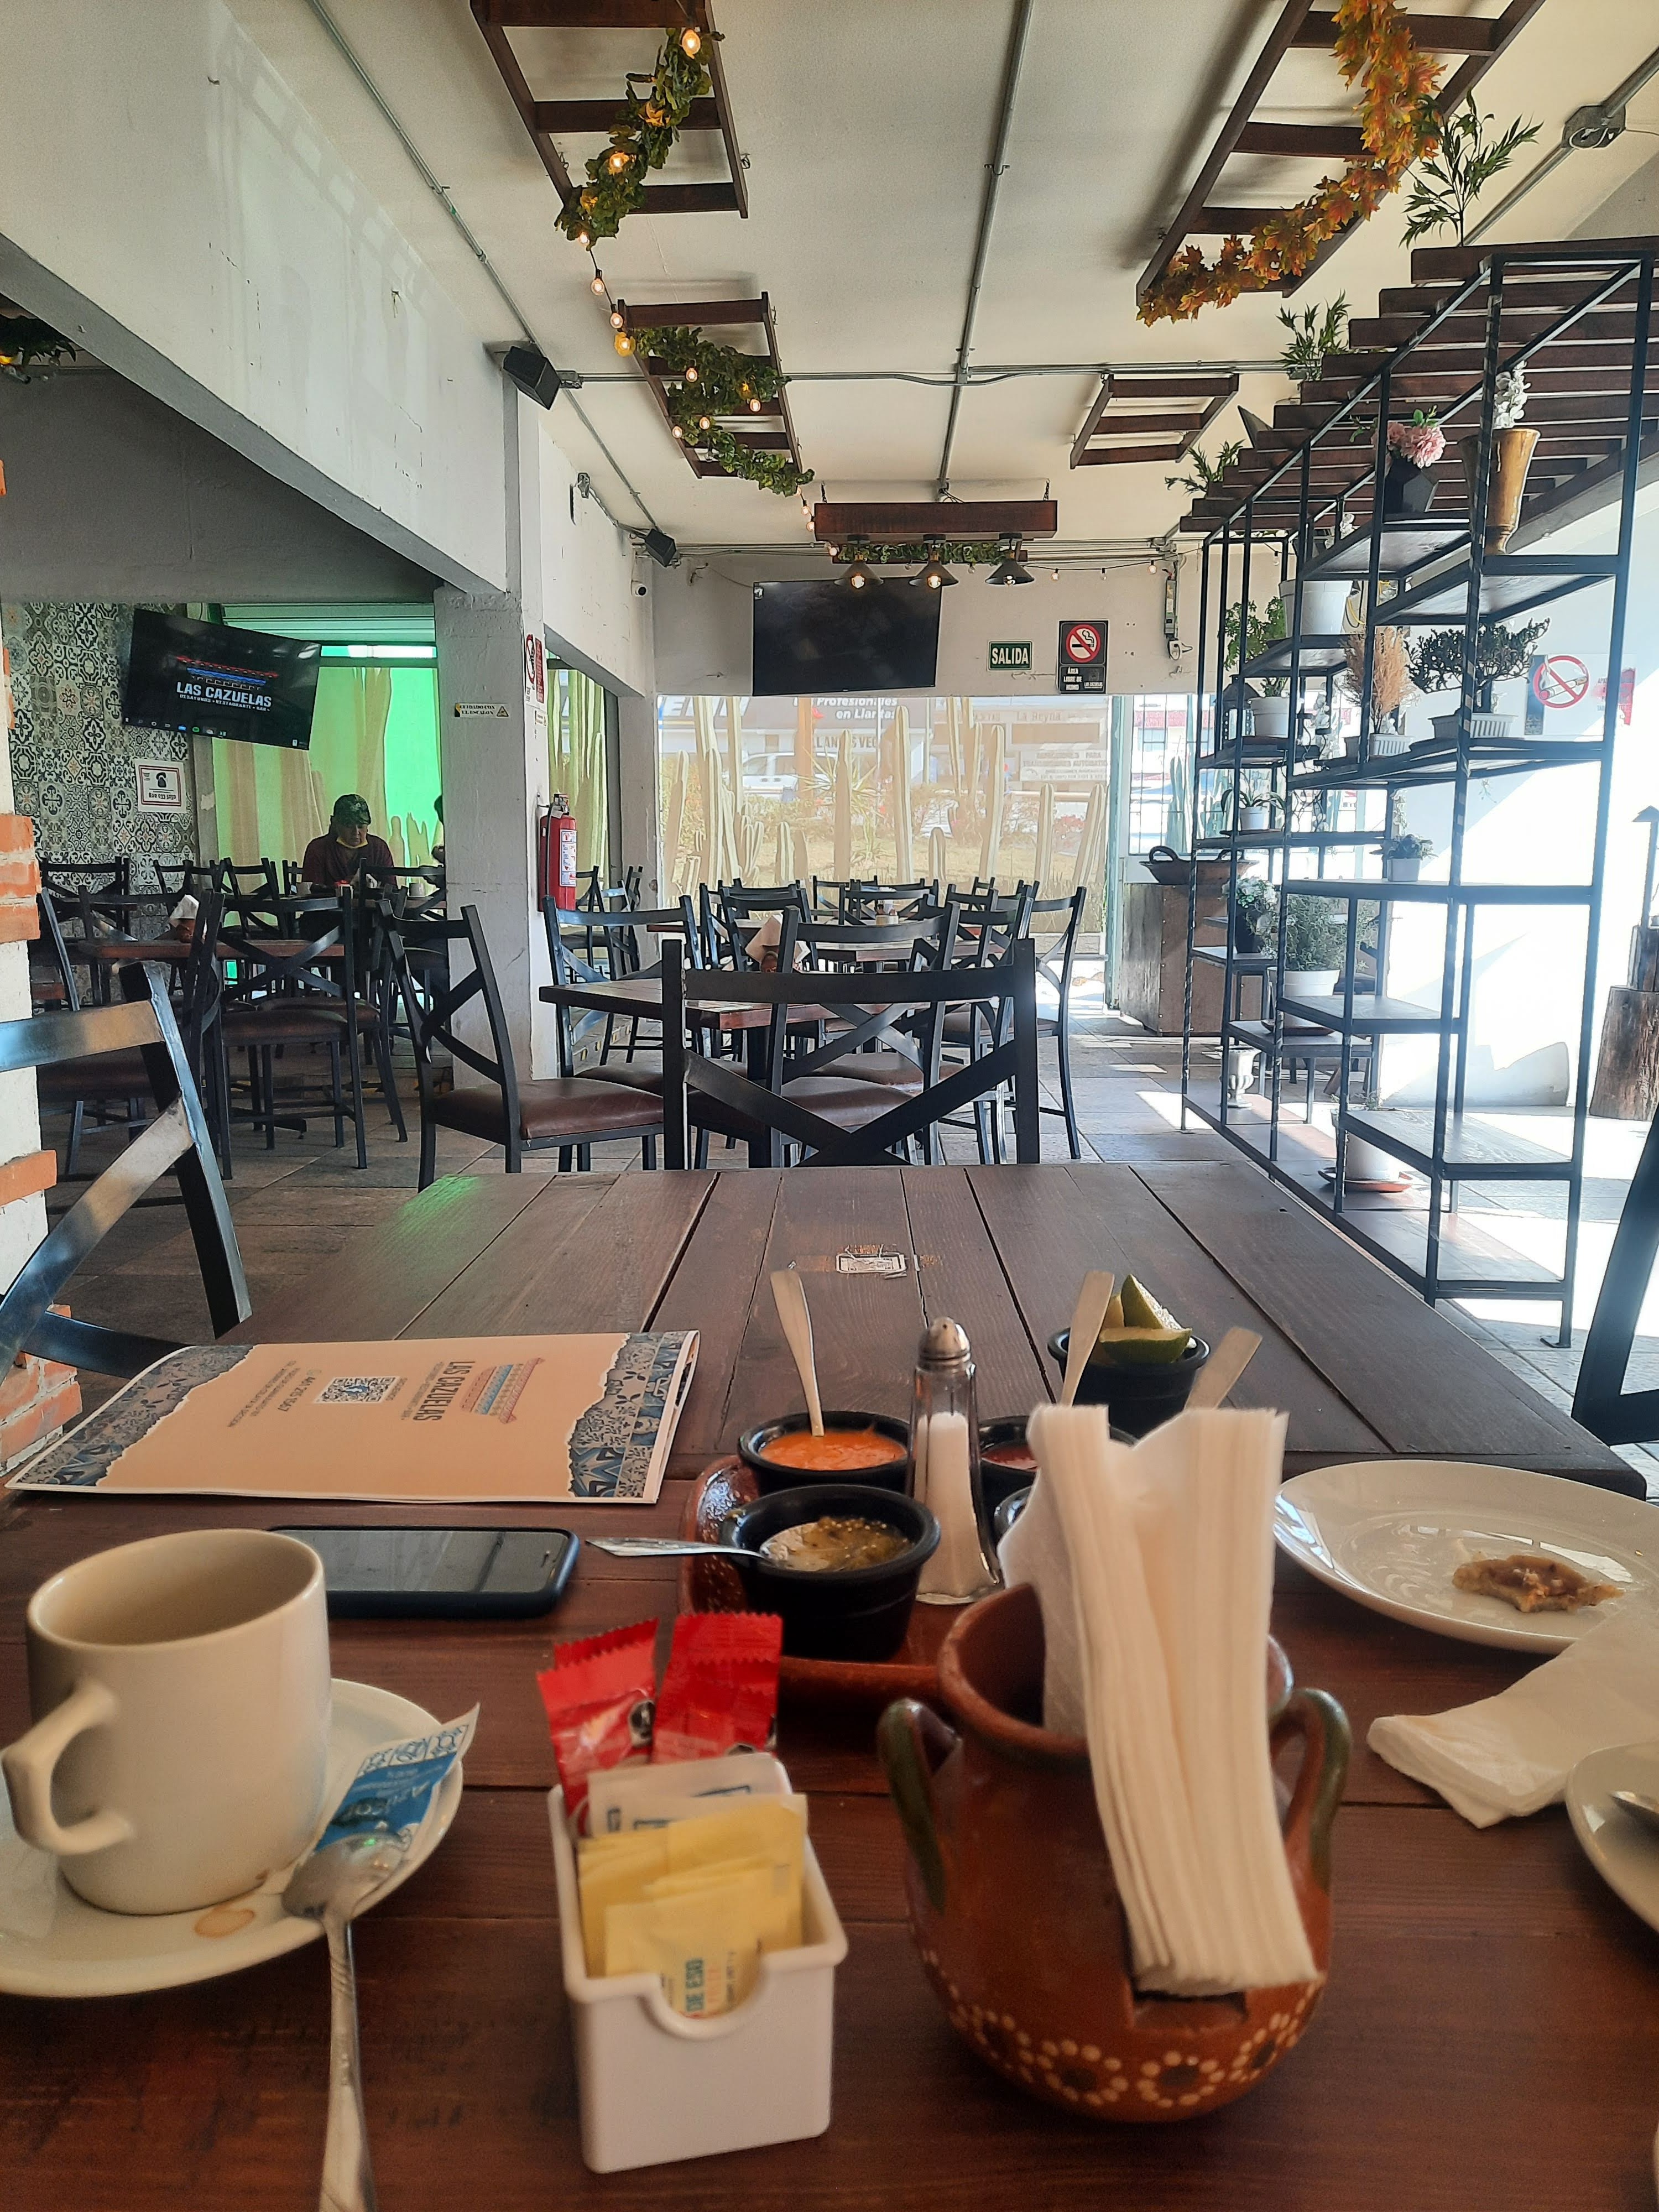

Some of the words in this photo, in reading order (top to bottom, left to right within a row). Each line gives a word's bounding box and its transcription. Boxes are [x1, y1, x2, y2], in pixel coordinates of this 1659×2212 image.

[992, 648, 1029, 664] SALIDA
[176, 681, 201, 696] LAS
[205, 686, 272, 707] CAZUELAS
[836, 711, 851, 719] en
[443, 1361, 476, 1374] LAS
[413, 1377, 465, 1421] CAZUELAS
